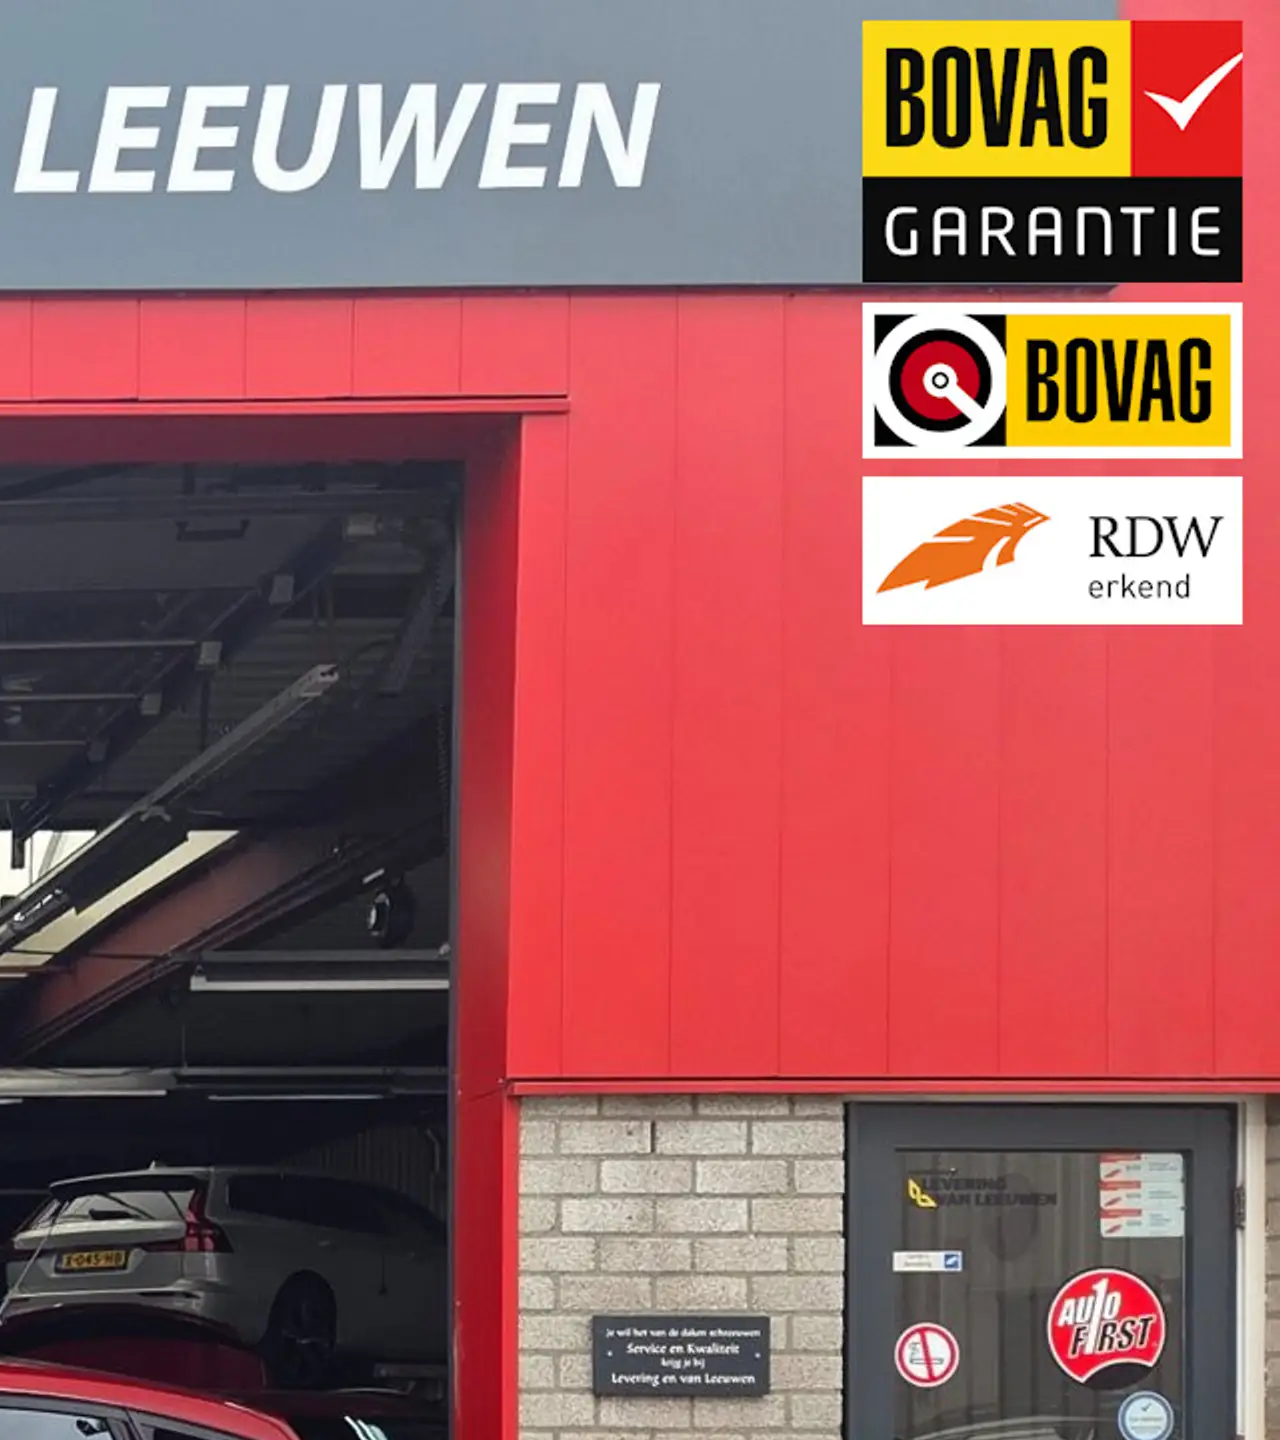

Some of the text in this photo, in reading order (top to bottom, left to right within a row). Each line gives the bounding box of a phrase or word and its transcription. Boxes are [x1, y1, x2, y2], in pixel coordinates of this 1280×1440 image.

[13, 82, 661, 194] LEEUWEN
[627, 1342, 740, 1354] Service en Kwaliteit
[1067, 1314, 1157, 1359] FIRST
[611, 1373, 756, 1387] Levering en van Leeuwen
